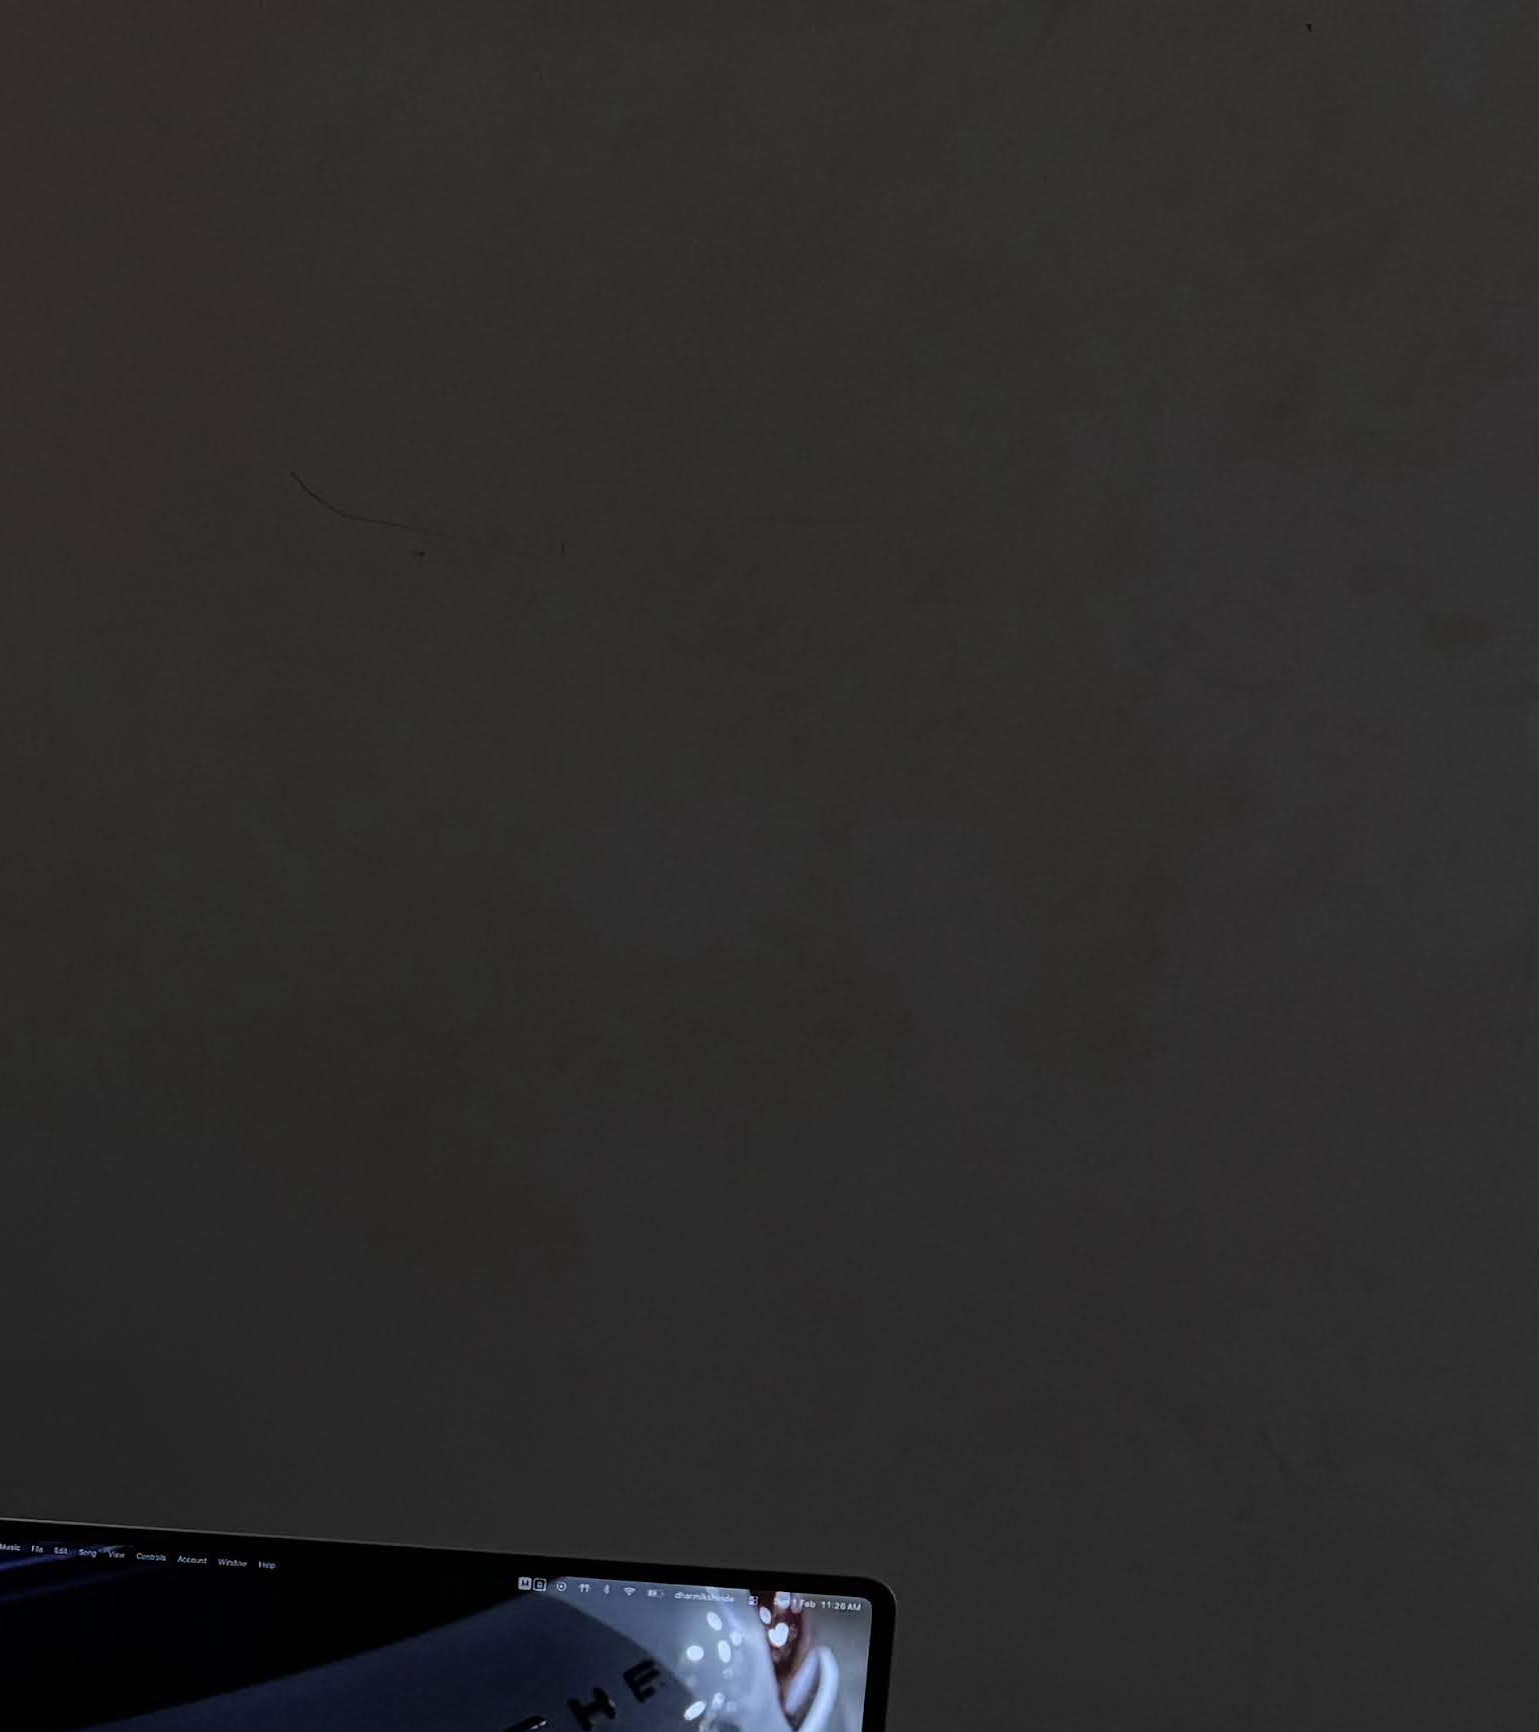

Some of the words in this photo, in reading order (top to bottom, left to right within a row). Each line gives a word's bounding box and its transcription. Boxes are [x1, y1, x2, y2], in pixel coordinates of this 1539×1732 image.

[0, 1543, 20, 1551] Music
[31, 1545, 43, 1553] File
[55, 1547, 68, 1555] Edit
[78, 1549, 97, 1558] Song
[107, 1551, 125, 1559] View
[136, 1553, 166, 1561] Controls
[177, 1556, 207, 1564] Account
[218, 1559, 247, 1567] Window
[259, 1561, 276, 1569] Help
